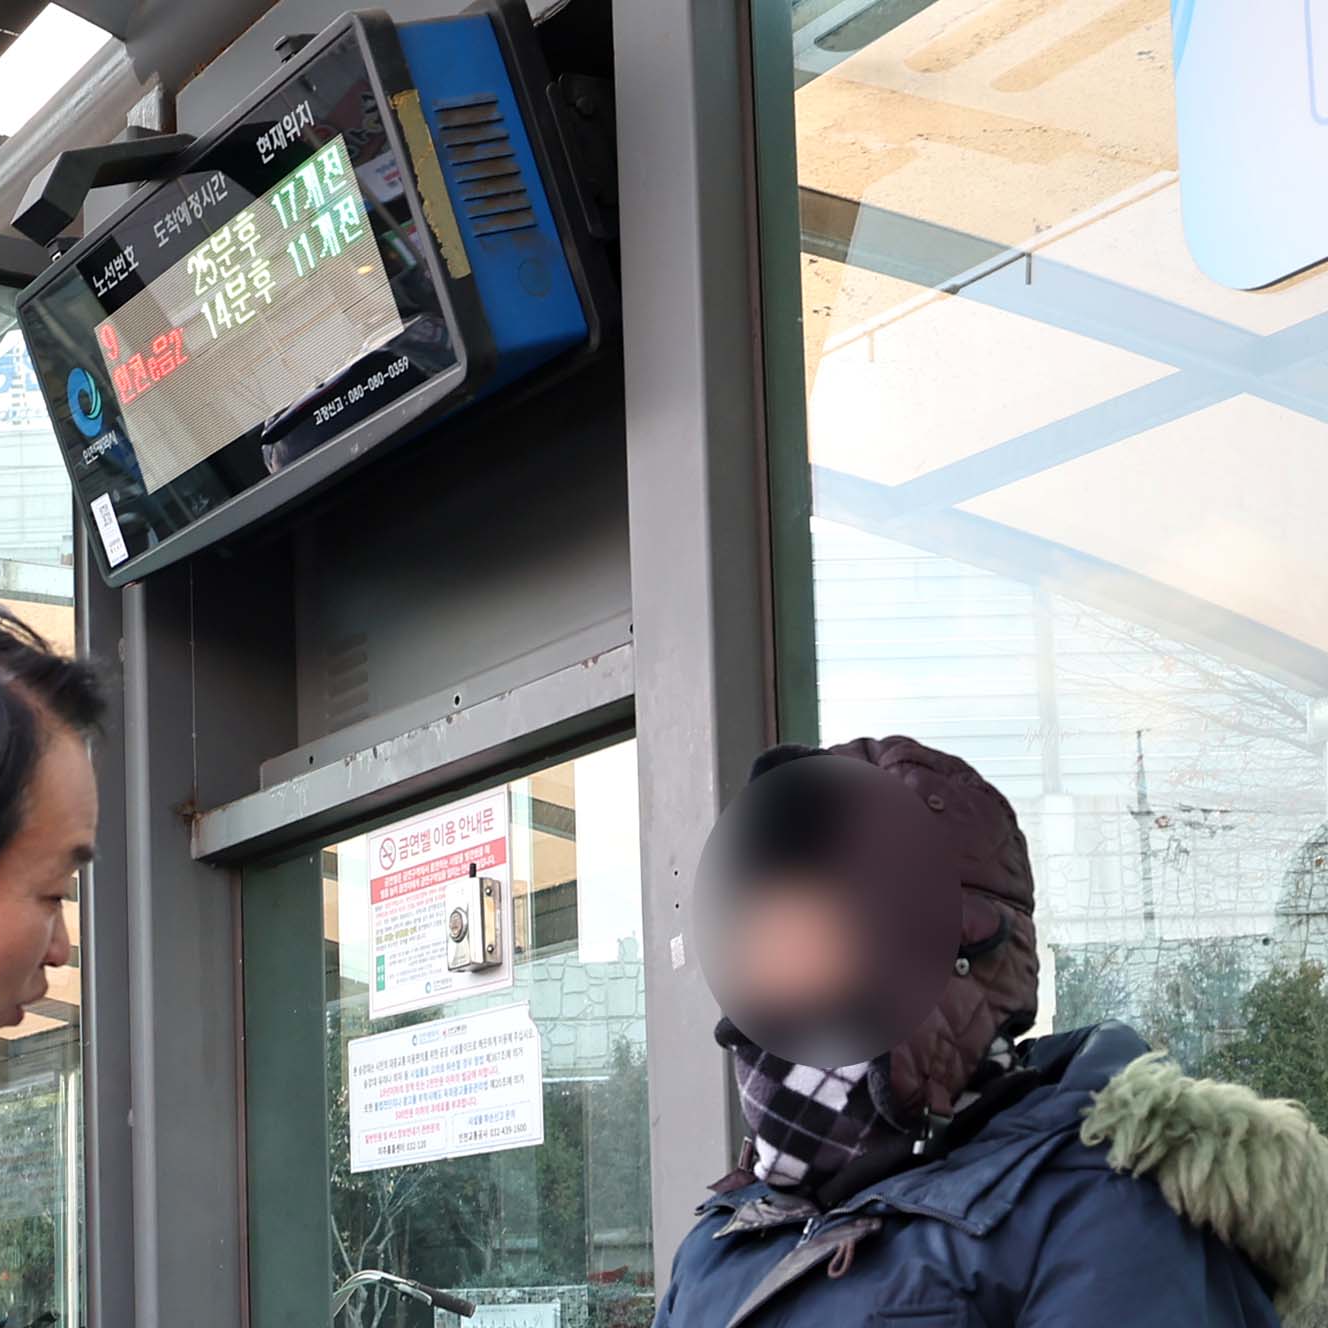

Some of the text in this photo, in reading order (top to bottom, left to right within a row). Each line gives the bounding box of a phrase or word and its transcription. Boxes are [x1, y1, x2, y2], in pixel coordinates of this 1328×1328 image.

[92, 245, 140, 298] 노선번호
[153, 172, 229, 248] 도착예정시간
[255, 100, 315, 164] 현재위치
[187, 211, 261, 296] 25분후
[201, 259, 276, 339] 14분후
[398, 808, 496, 861] 금연벨 이용 안내문
